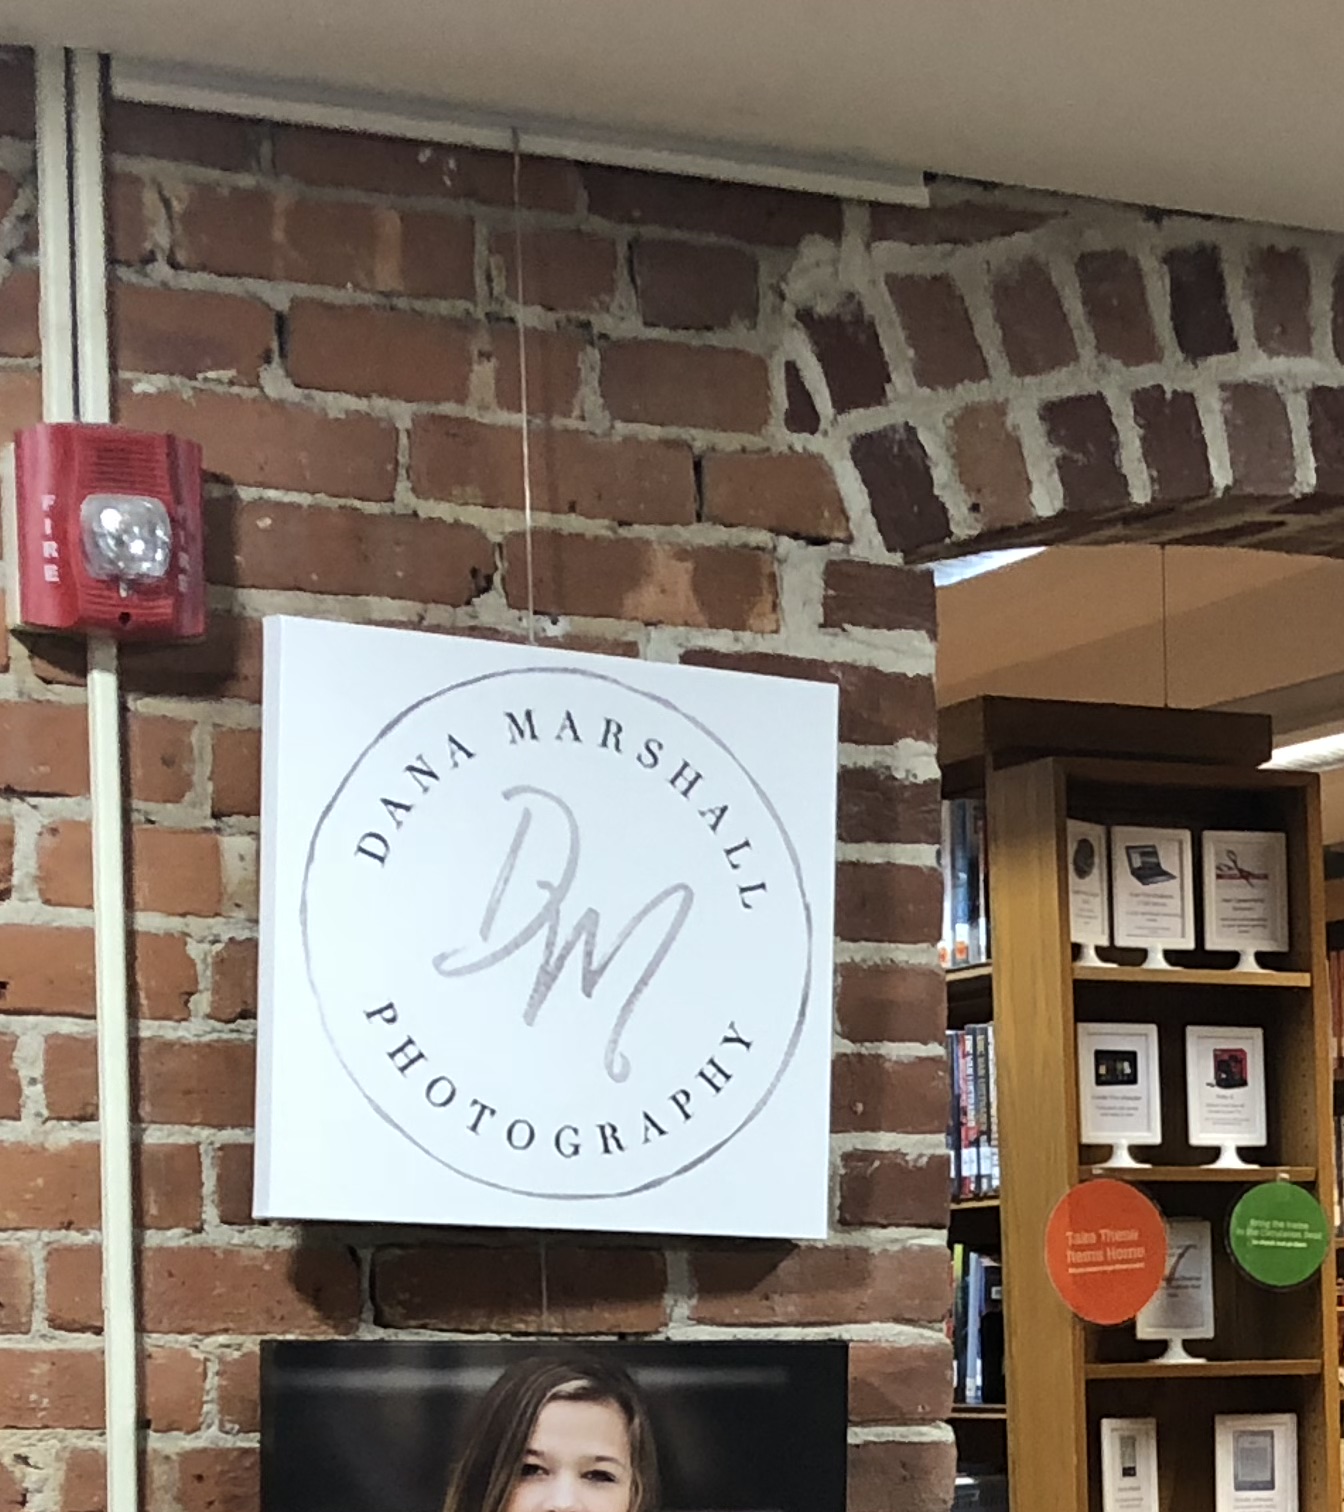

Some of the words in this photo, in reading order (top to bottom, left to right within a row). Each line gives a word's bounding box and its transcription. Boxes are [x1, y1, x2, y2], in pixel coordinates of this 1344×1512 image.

[41, 494, 59, 582] FIRE
[354, 730, 476, 868] DANA
[506, 707, 771, 912] MARSHALL
[364, 1000, 755, 1158] PHOTOGRAPHY
[1107, 1247, 1145, 1262] Home
